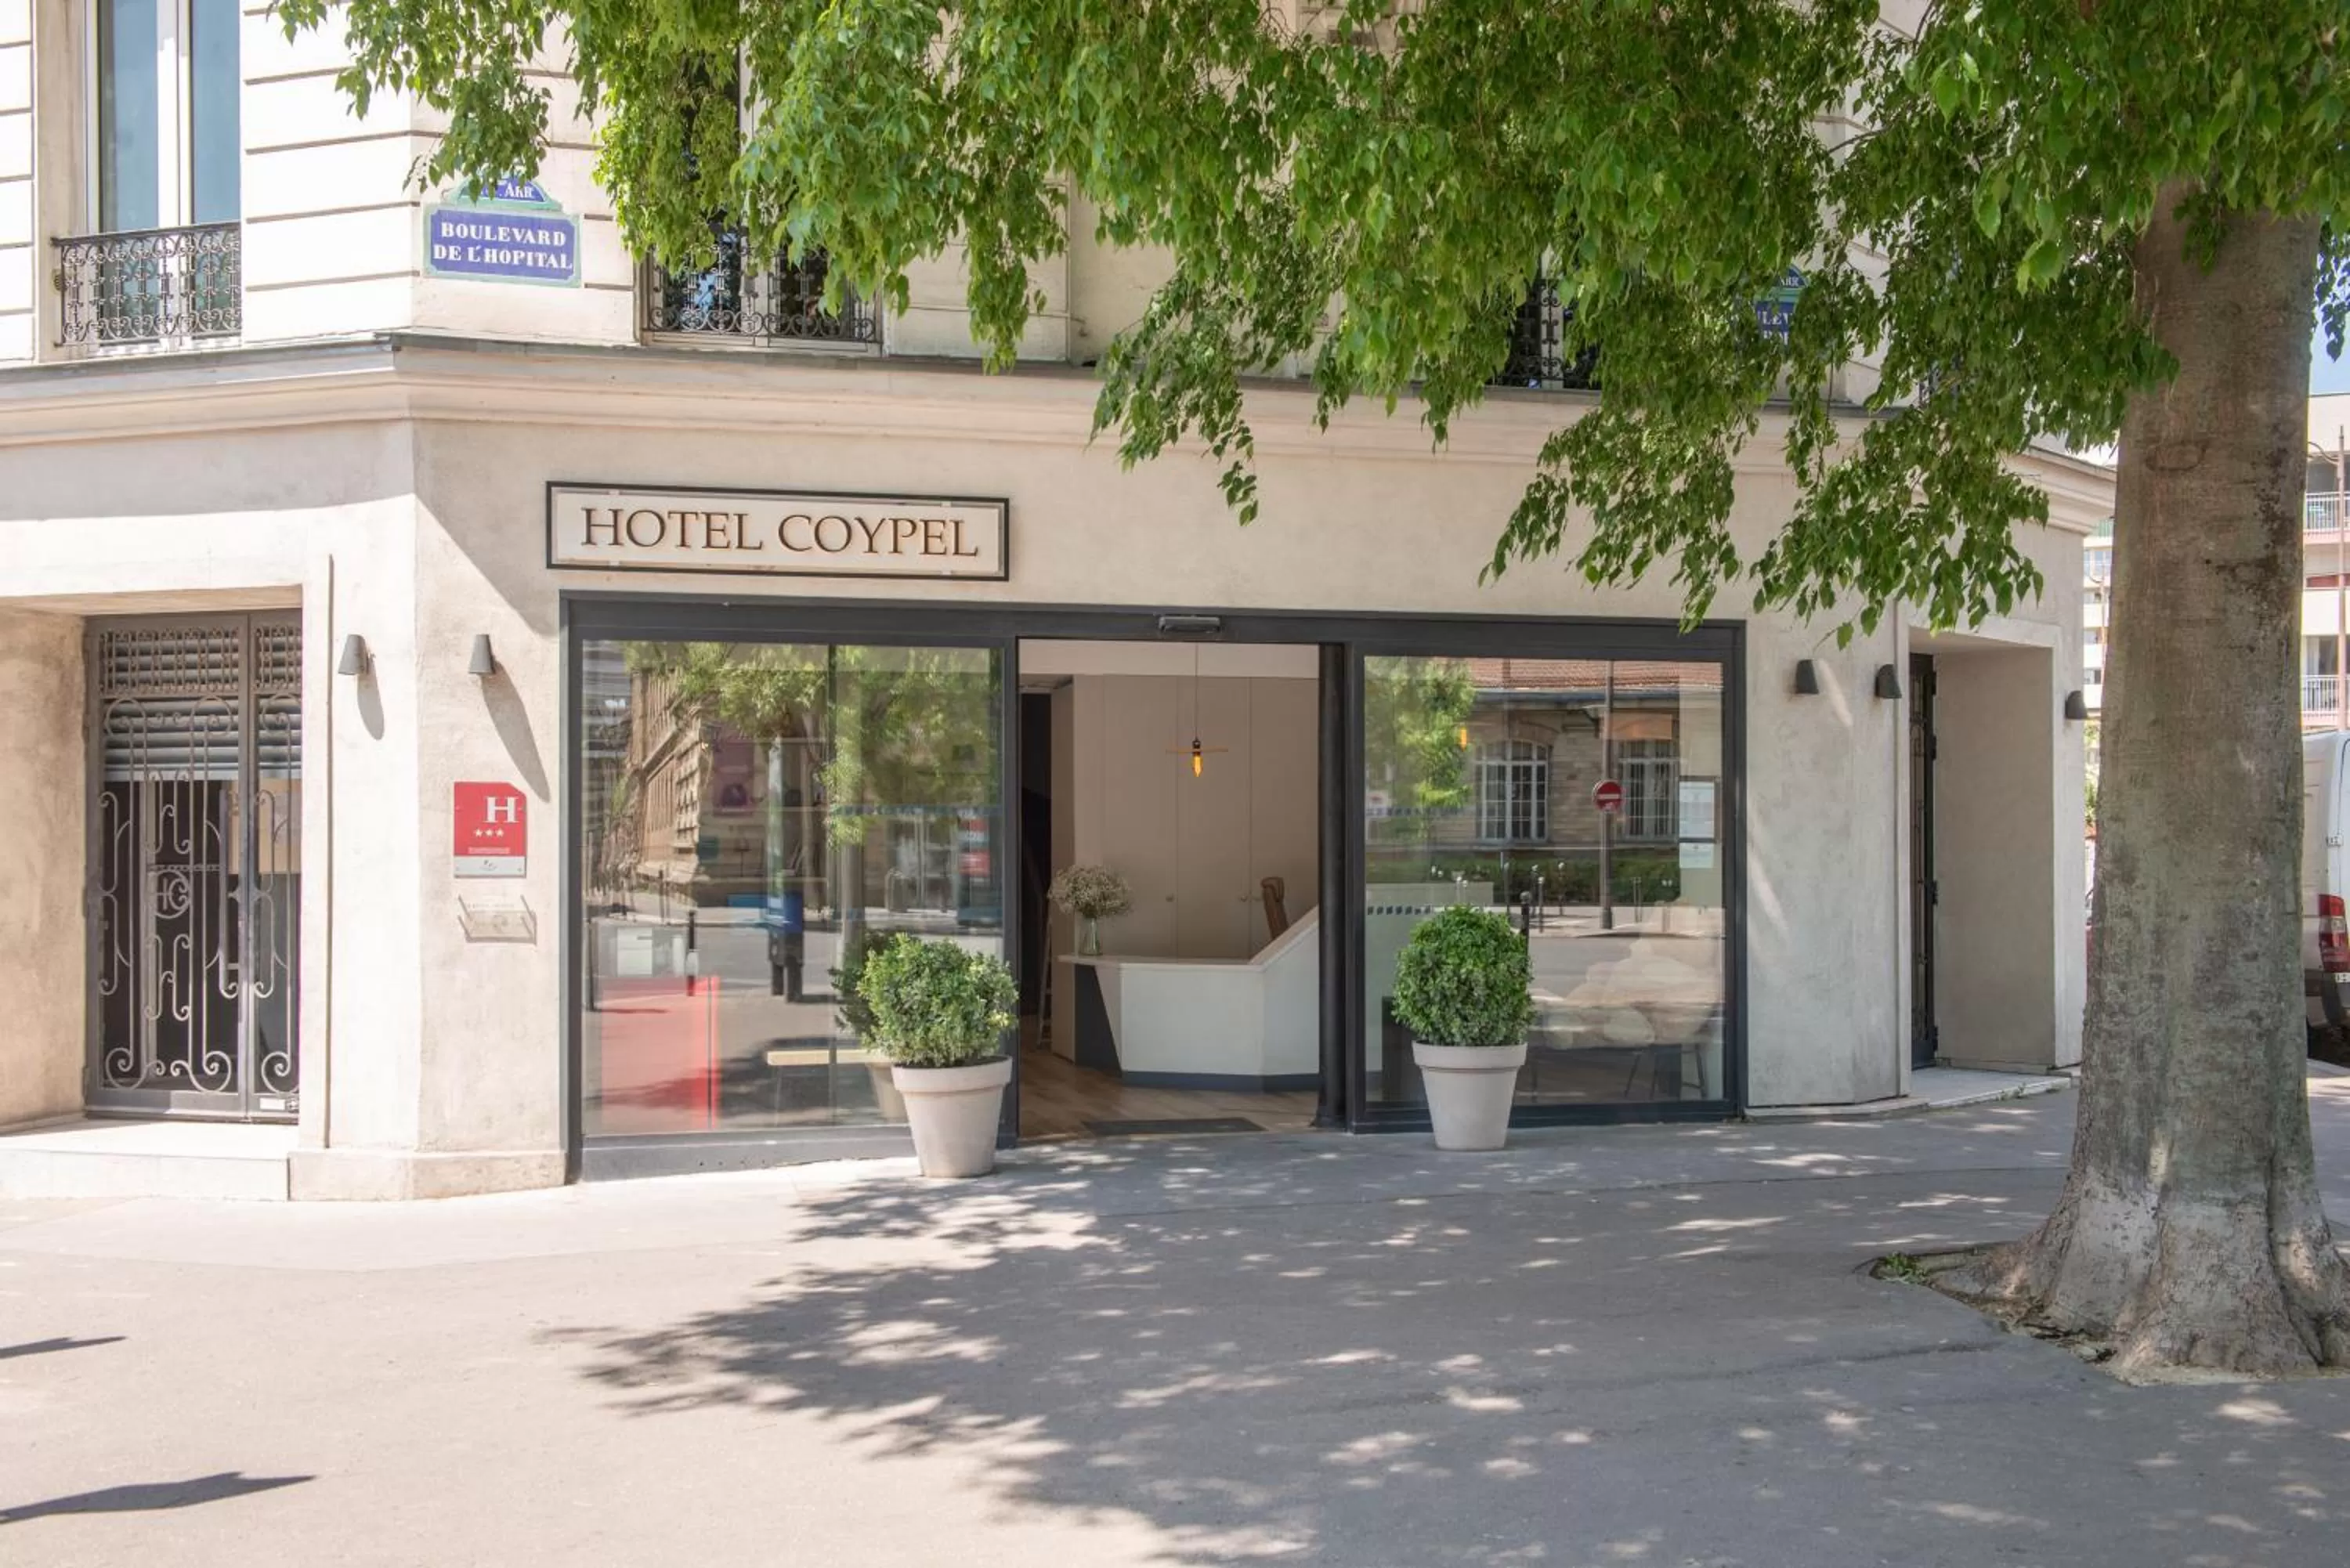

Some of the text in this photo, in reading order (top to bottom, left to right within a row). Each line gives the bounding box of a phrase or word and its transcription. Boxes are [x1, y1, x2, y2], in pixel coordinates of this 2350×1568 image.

[441, 222, 566, 247] BOULEVARD
[433, 244, 573, 269] DE L'HOPITAL
[580, 507, 978, 556] HOTEL COYPEL
[483, 796, 520, 824] H
